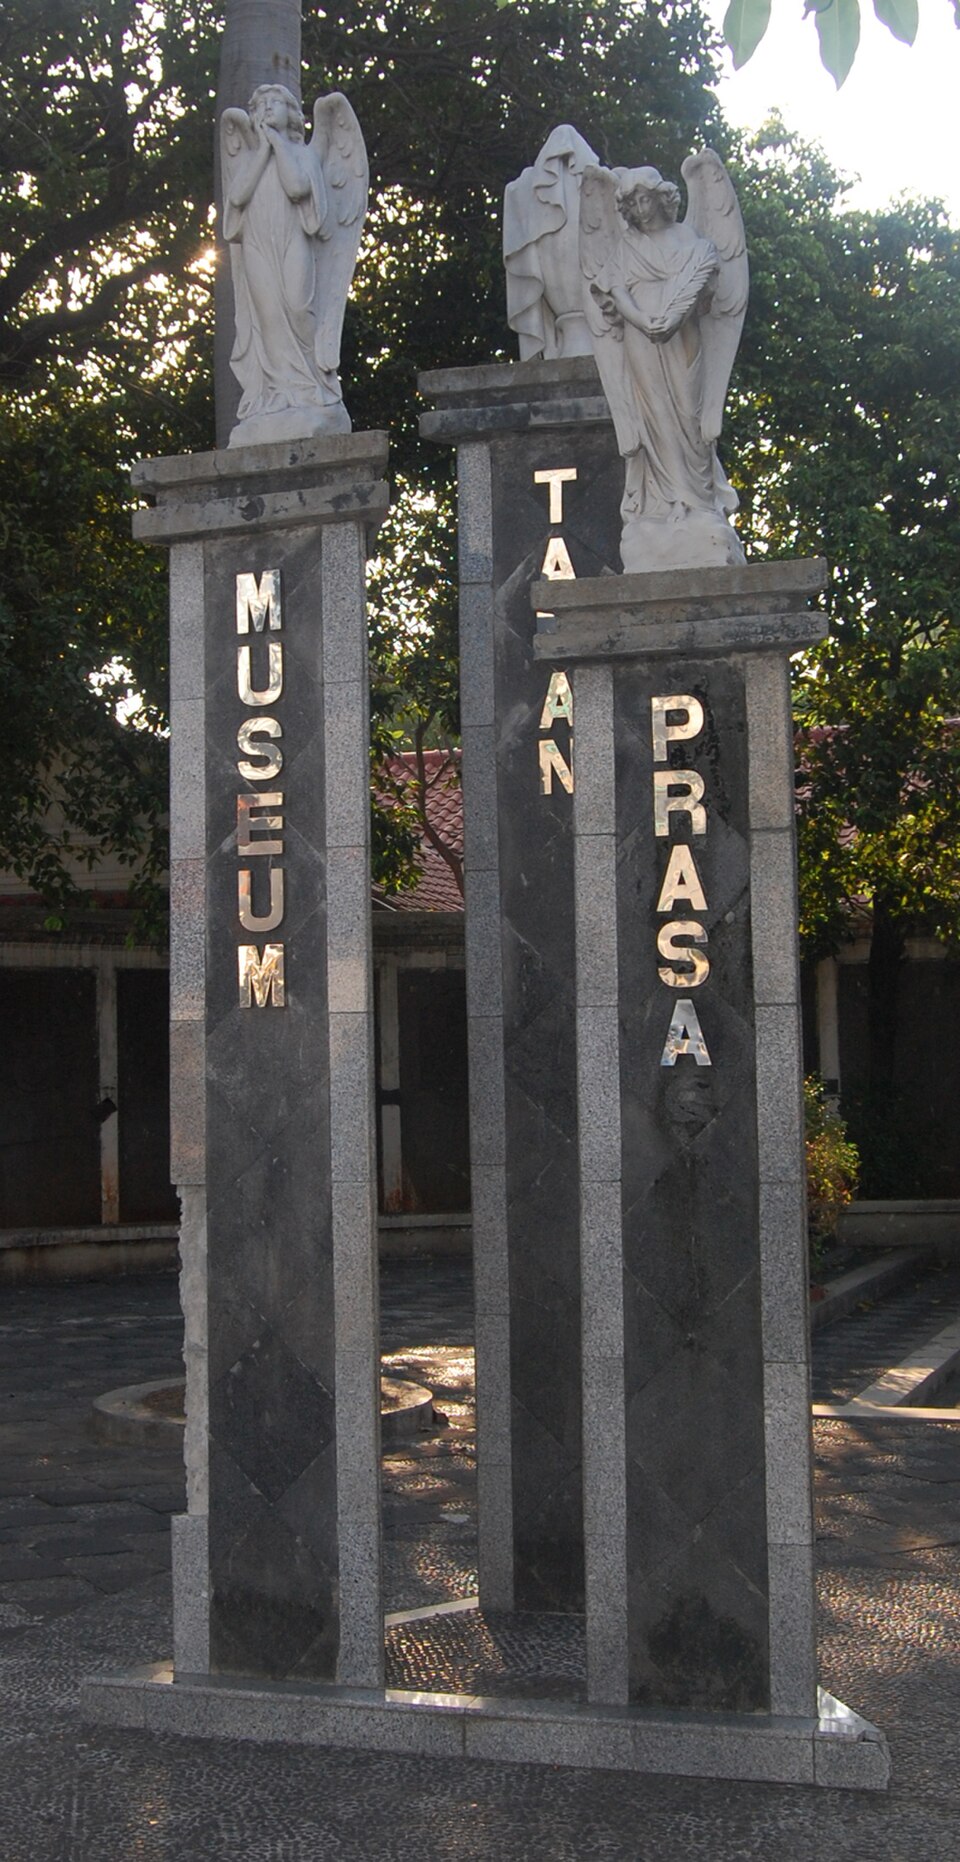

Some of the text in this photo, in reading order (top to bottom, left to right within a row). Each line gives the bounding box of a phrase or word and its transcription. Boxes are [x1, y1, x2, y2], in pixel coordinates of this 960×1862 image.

[235, 569, 285, 1008] MUSEUM
[534, 467, 577, 795] TAAN
[651, 694, 712, 1067] PRASA
